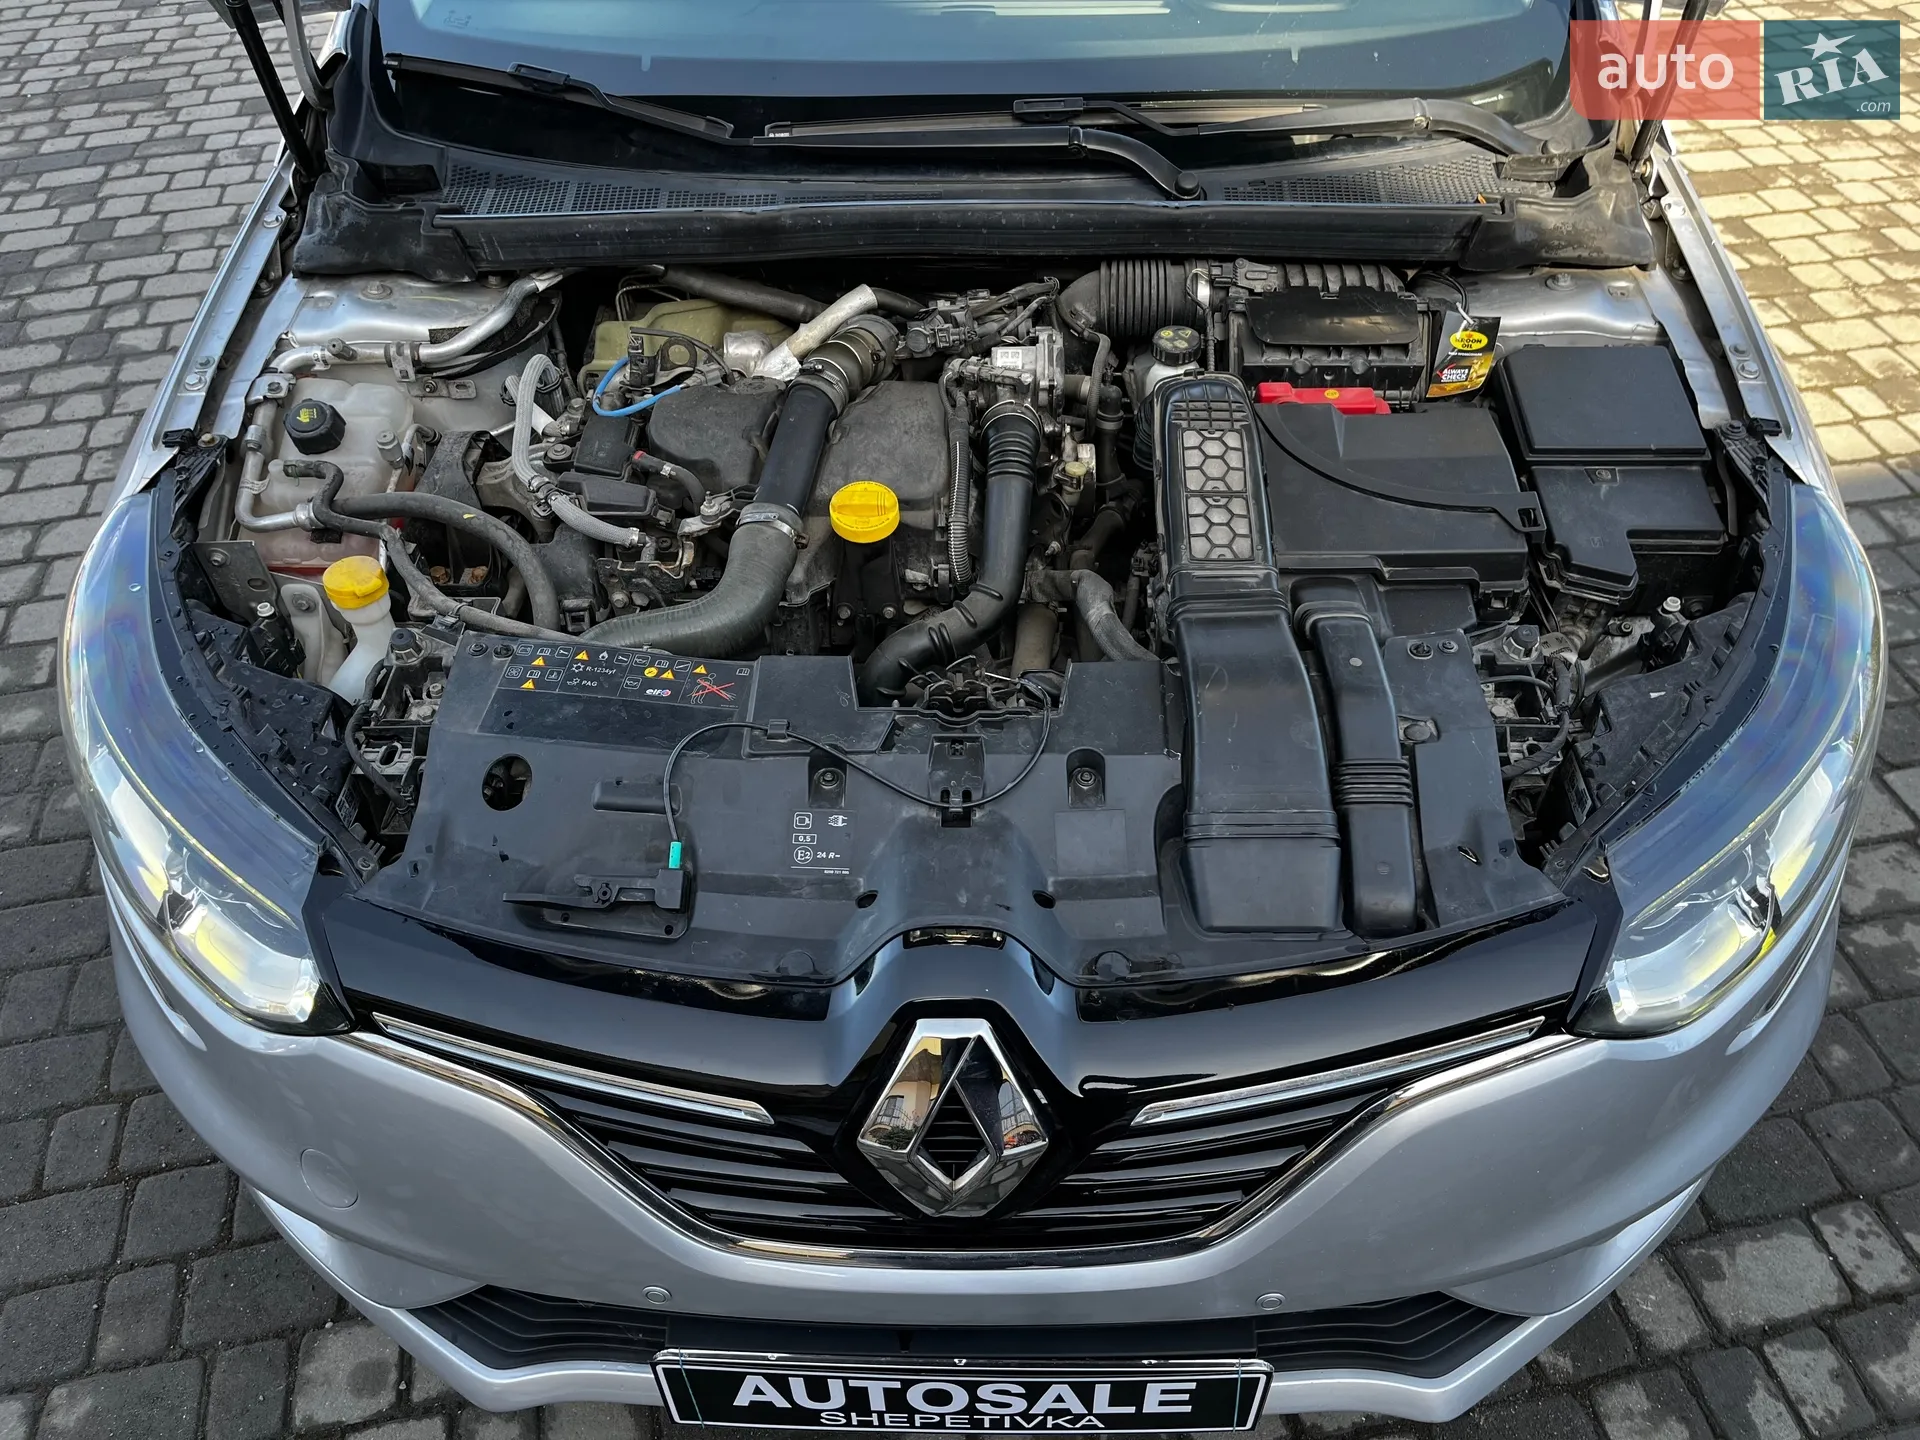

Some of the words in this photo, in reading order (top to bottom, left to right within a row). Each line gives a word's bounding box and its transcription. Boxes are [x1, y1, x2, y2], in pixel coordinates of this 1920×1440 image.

[798, 835, 811, 843] 0,5
[797, 850, 811, 860] E2
[816, 851, 827, 859] 24
[732, 1374, 1197, 1415] AUTOSALE
[820, 1411, 1106, 1429] SHEPETIVKA
